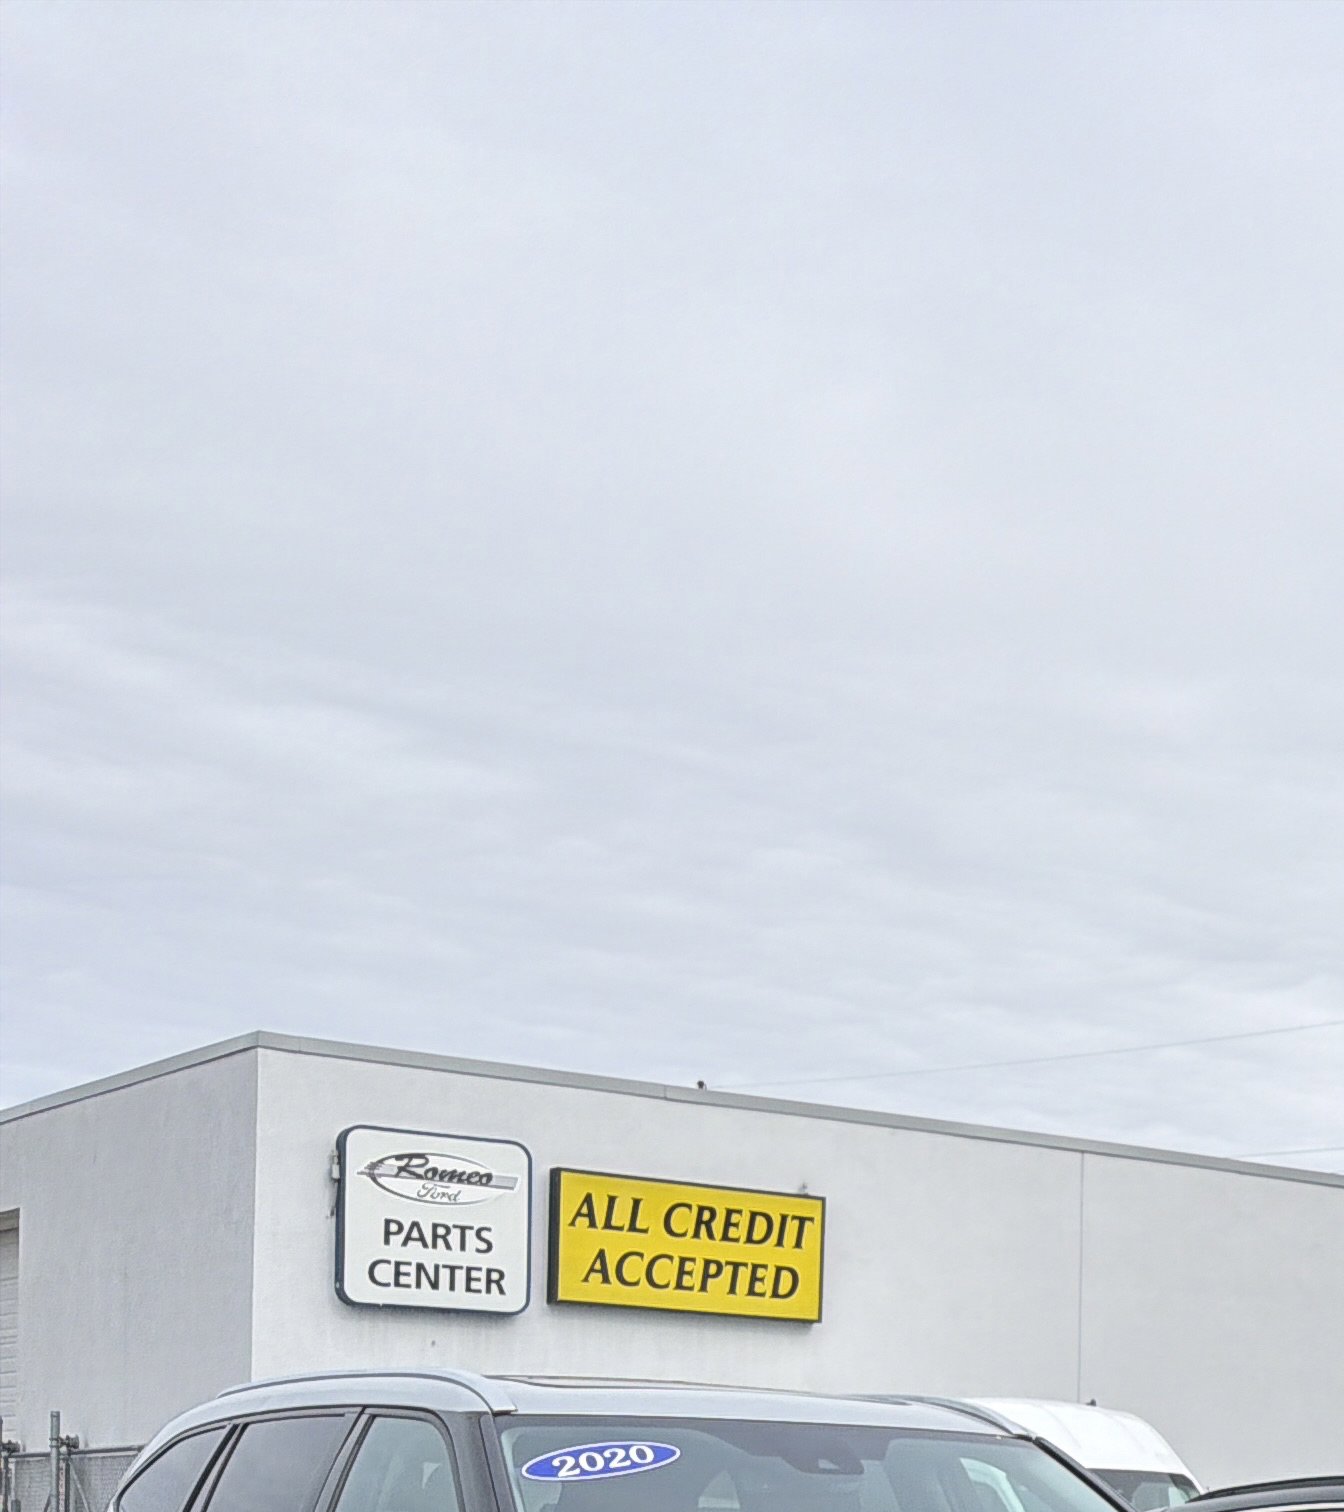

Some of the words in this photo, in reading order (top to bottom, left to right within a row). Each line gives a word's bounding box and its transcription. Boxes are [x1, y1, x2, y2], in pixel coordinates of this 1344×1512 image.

[394, 1152, 494, 1186] Romeo
[416, 1181, 463, 1202] Ford
[383, 1217, 494, 1255] PARTS
[567, 1191, 650, 1235] ALL
[662, 1201, 816, 1250] CREDIT
[367, 1258, 507, 1297] CENTER
[580, 1247, 801, 1300] ACCEPTED
[551, 1444, 655, 1478] 2020
